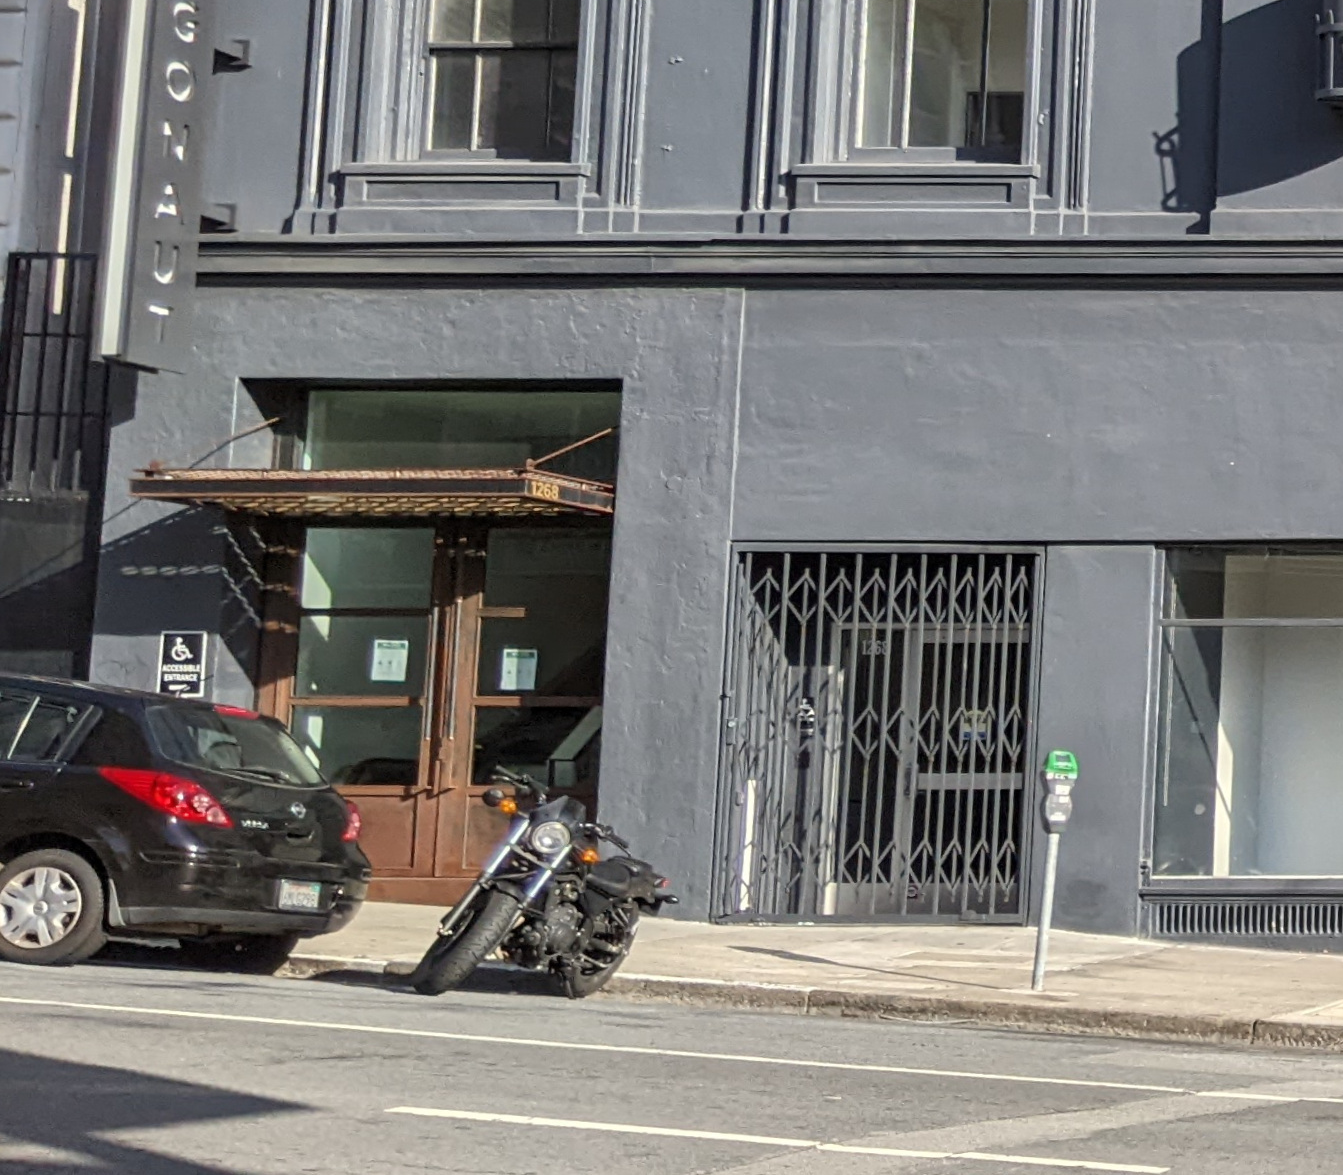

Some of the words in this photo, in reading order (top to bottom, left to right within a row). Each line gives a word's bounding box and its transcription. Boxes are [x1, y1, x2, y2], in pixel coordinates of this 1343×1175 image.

[531, 480, 559, 500] 1268
[162, 664, 200, 672] ACCESSIBLE
[163, 673, 198, 682] ENTRANCE
